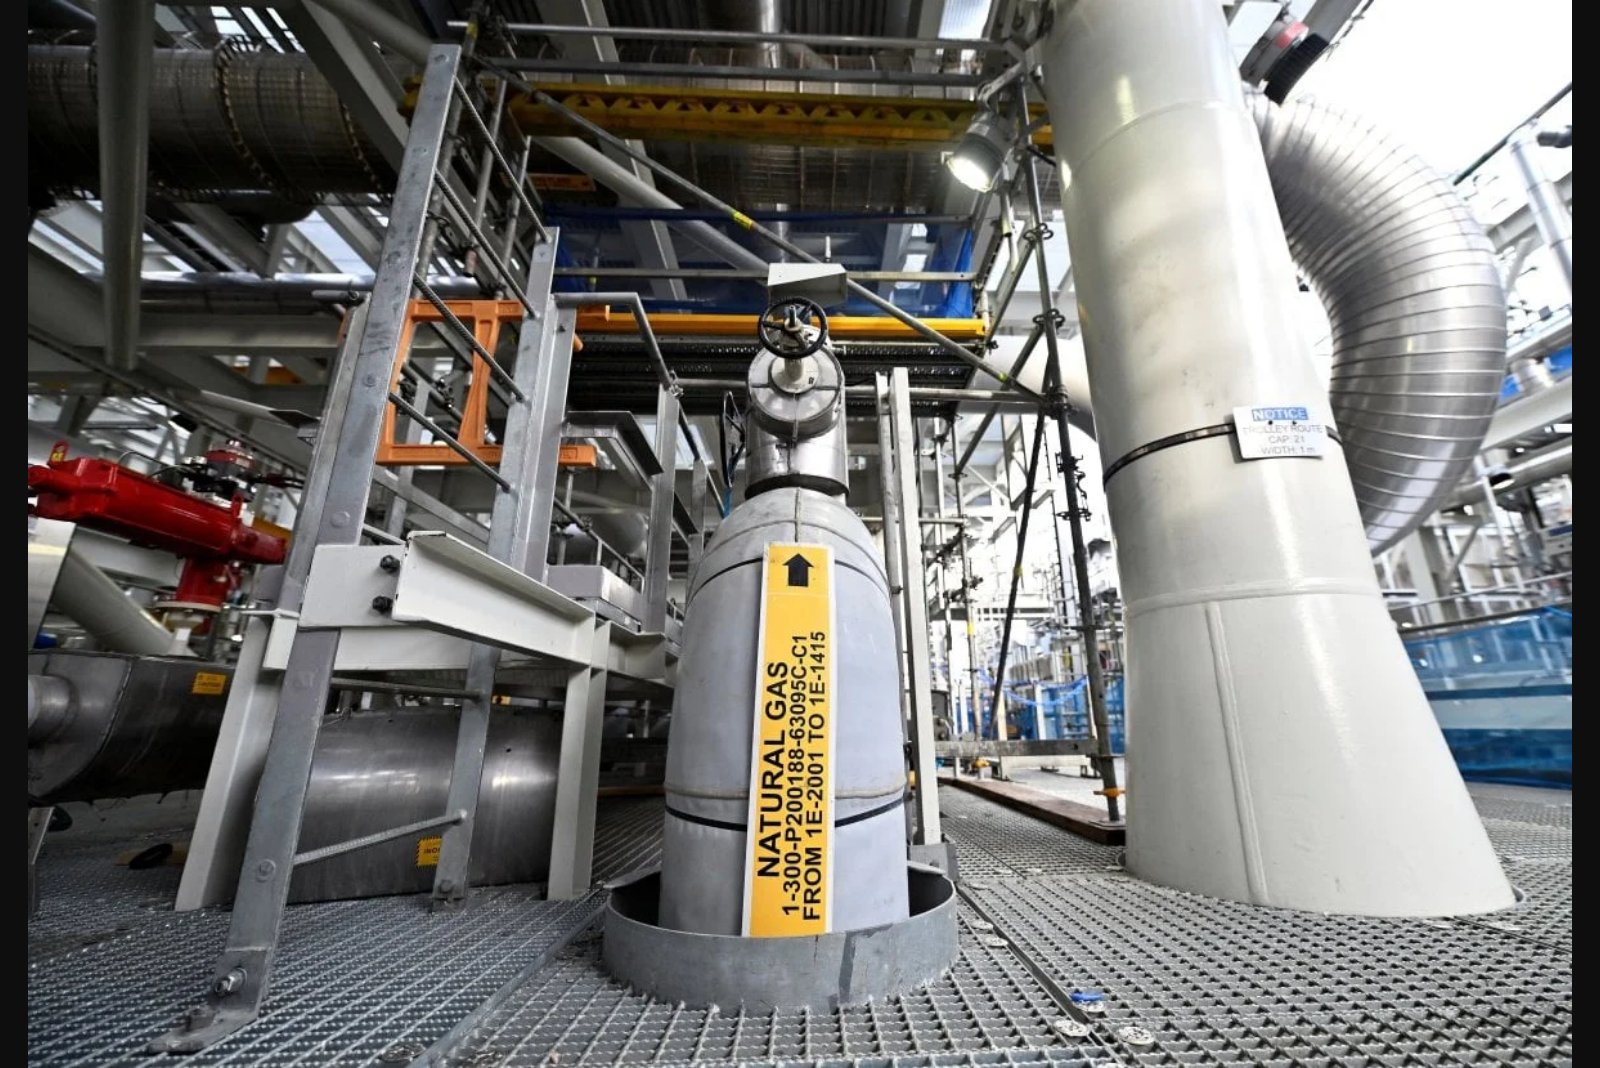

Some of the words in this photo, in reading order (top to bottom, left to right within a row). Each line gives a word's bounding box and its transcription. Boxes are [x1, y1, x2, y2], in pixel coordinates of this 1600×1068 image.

[1252, 408, 1308, 420] NOTICE
[1291, 424, 1323, 433] ROUTE
[765, 661, 788, 721] GAS
[809, 630, 826, 706] 1E-1415
[808, 713, 825, 743] TO
[757, 730, 786, 877] NATURAL
[782, 636, 808, 916] 1-300-P200188-63095C-C1
[806, 751, 824, 838] 1E-2001
[803, 847, 822, 921] FROM
